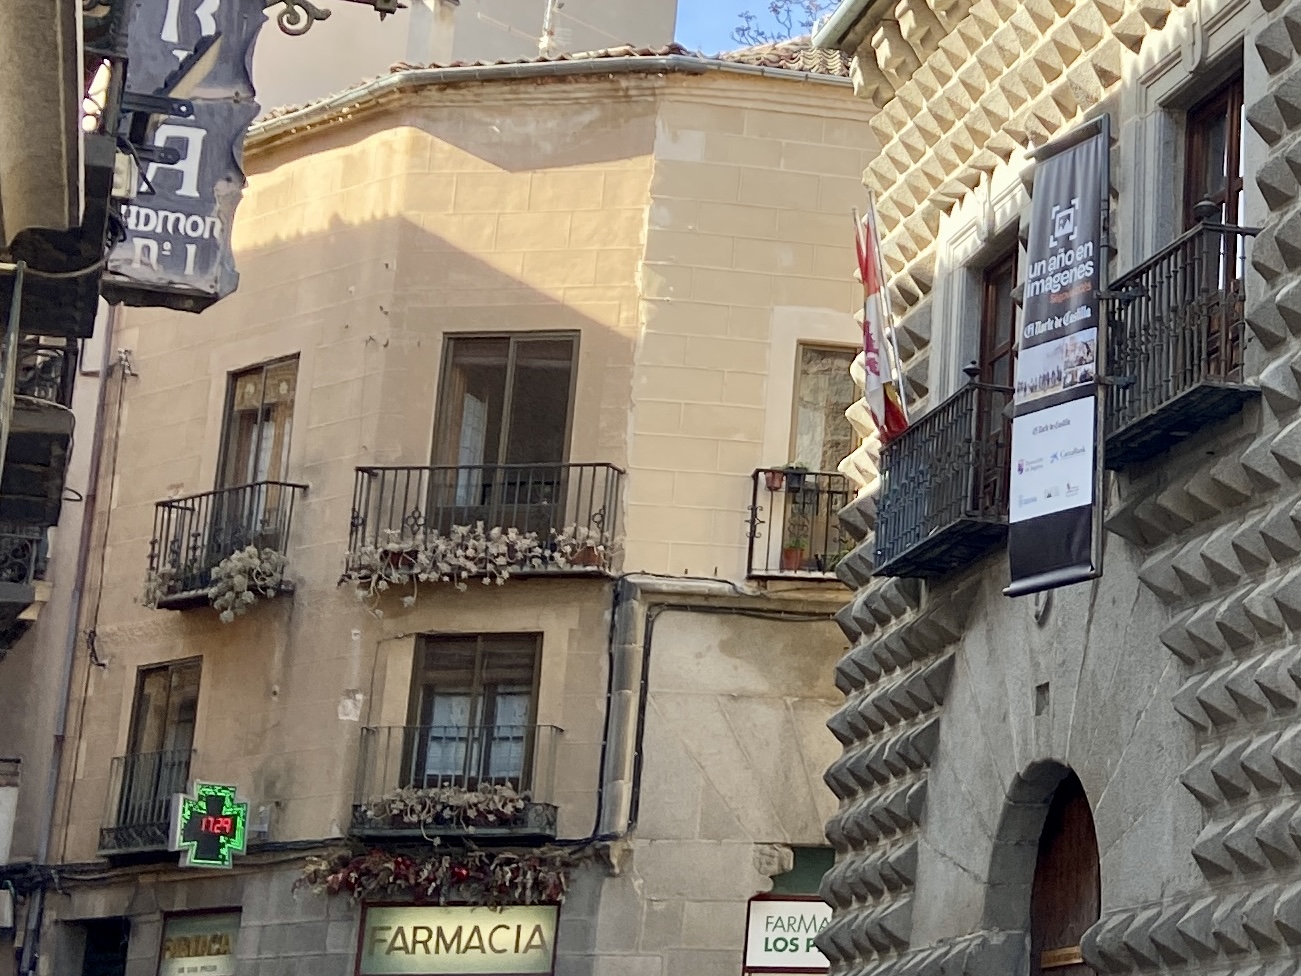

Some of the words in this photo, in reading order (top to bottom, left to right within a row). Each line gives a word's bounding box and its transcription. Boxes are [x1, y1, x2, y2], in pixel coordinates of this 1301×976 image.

[1029, 259, 1047, 278] un
[1047, 247, 1075, 272] año
[1075, 241, 1093, 261] en
[1026, 260, 1094, 298] imágenes
[367, 924, 549, 956] FARMACIA
[764, 937, 799, 952] LOS
[805, 938, 822, 952] P
